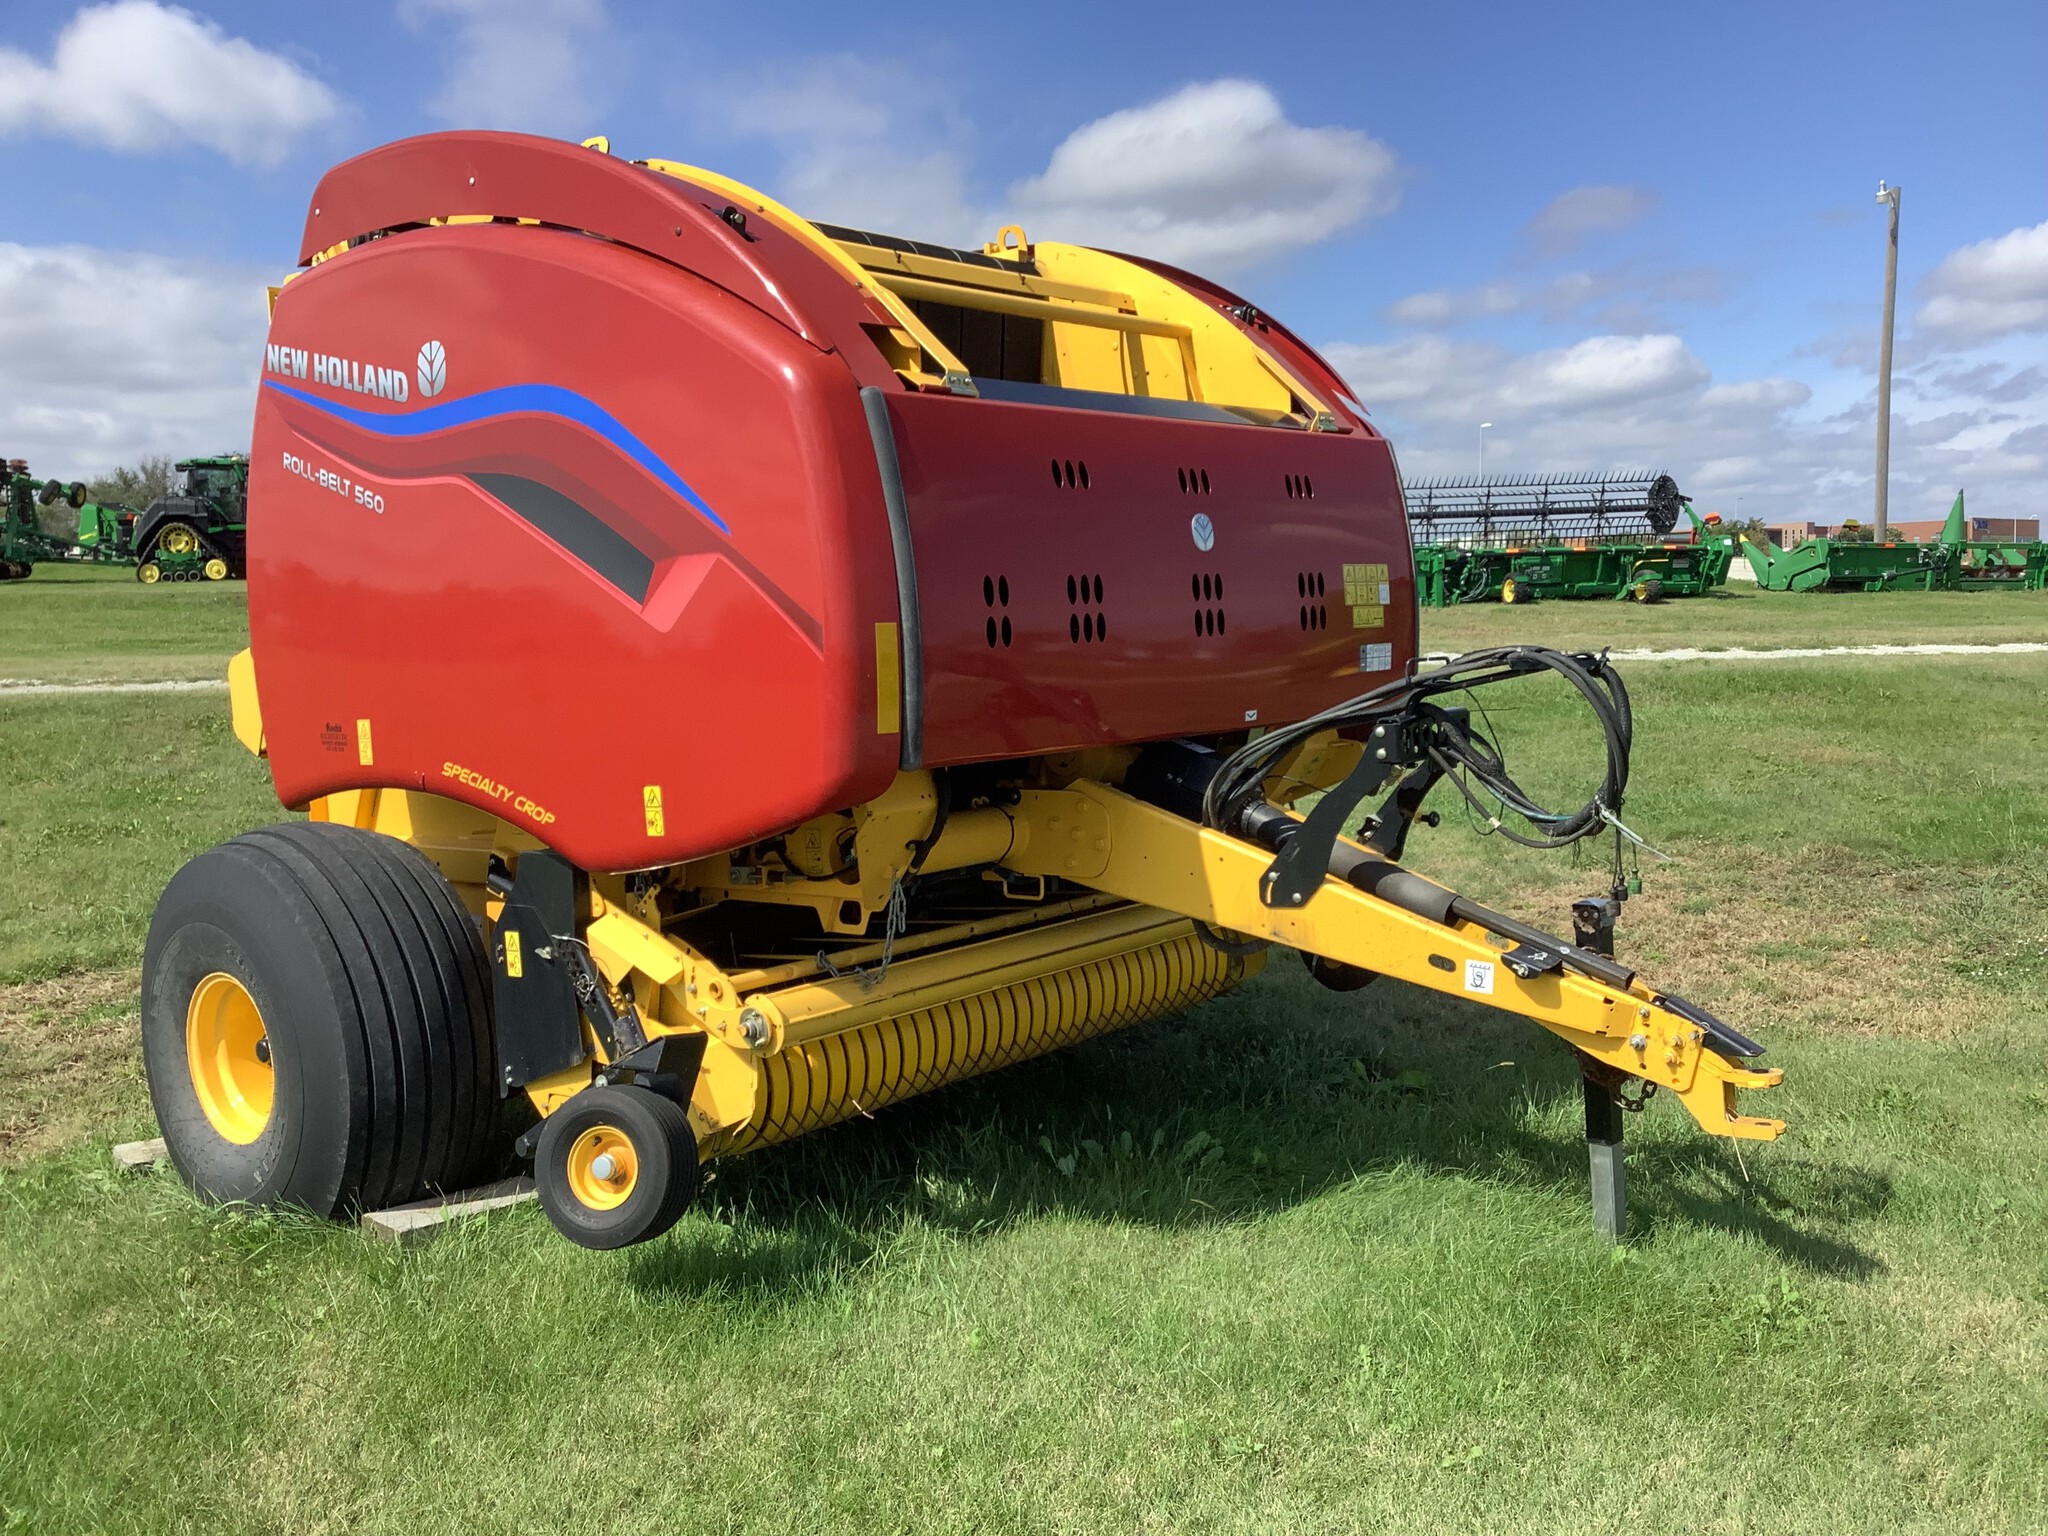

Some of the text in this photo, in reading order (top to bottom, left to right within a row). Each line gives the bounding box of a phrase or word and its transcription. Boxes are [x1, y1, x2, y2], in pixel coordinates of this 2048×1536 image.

[267, 343, 408, 403] NEW HOLLAND
[283, 452, 384, 514] ROLL-BELT 560
[441, 761, 556, 824] SPECIALTY CROP
